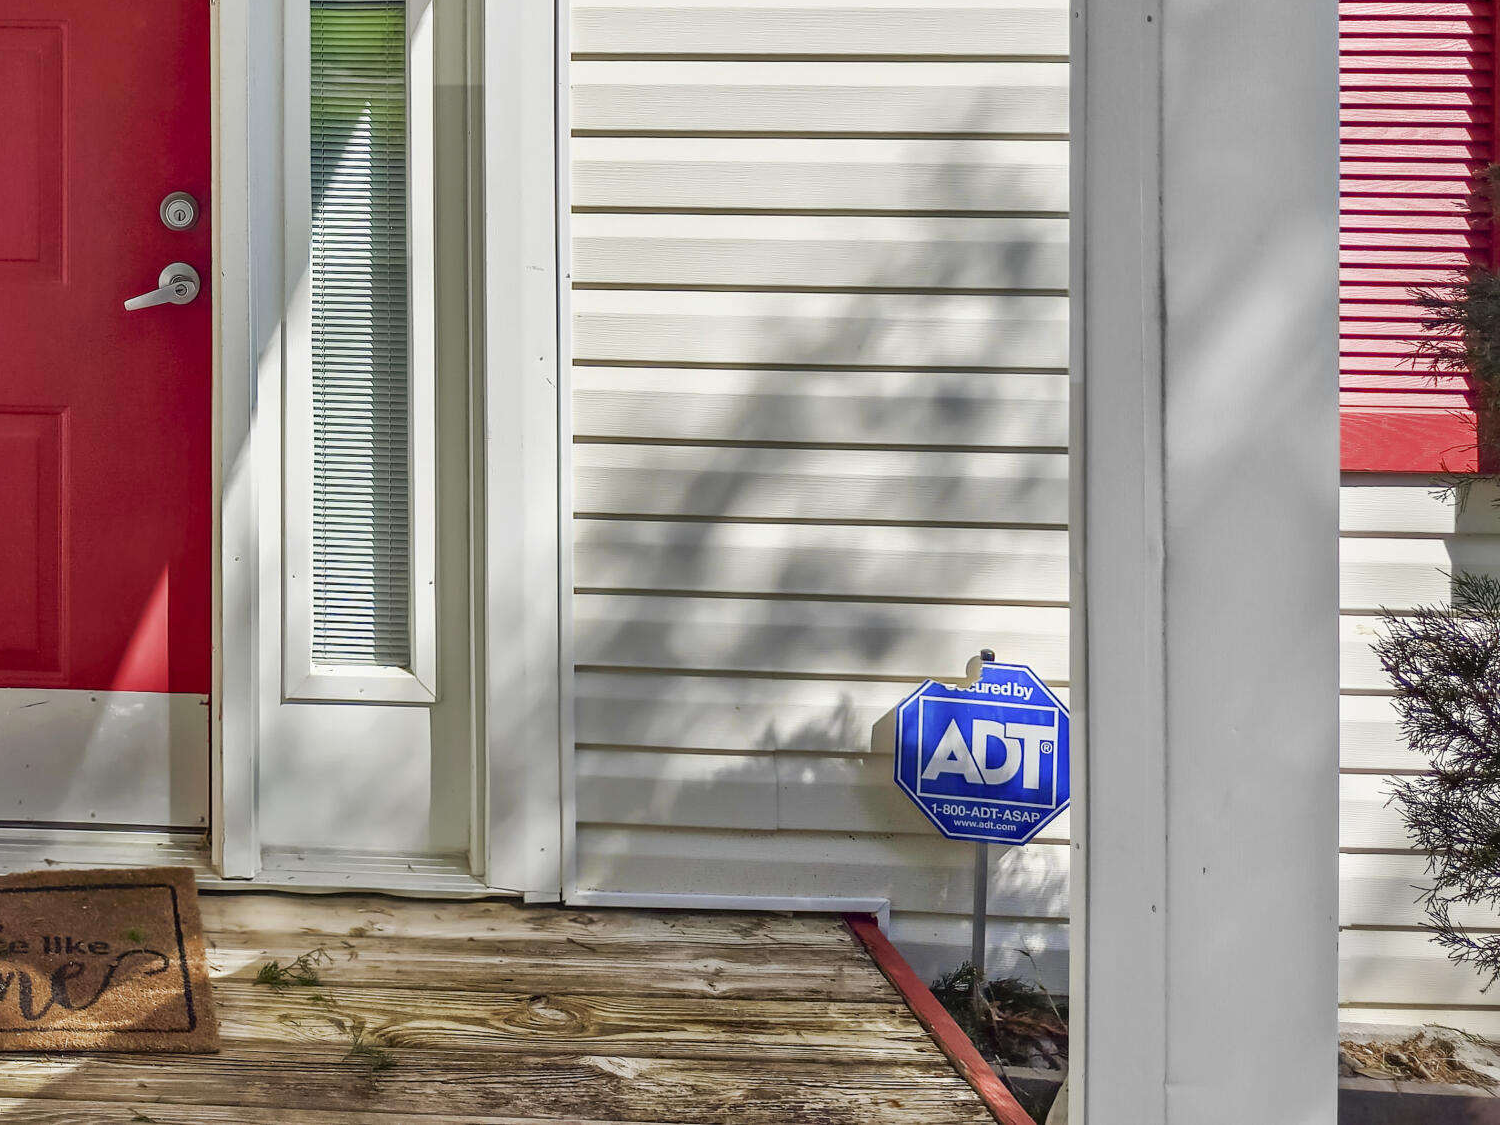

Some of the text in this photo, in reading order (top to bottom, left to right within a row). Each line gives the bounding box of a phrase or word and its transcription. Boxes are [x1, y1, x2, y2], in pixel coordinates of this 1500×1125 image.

[945, 681, 1033, 700] cured by
[931, 803, 1040, 823] 1-800-ADT-ASAP
[953, 818, 1017, 832] www.adt.com
[43, 935, 111, 955] like
